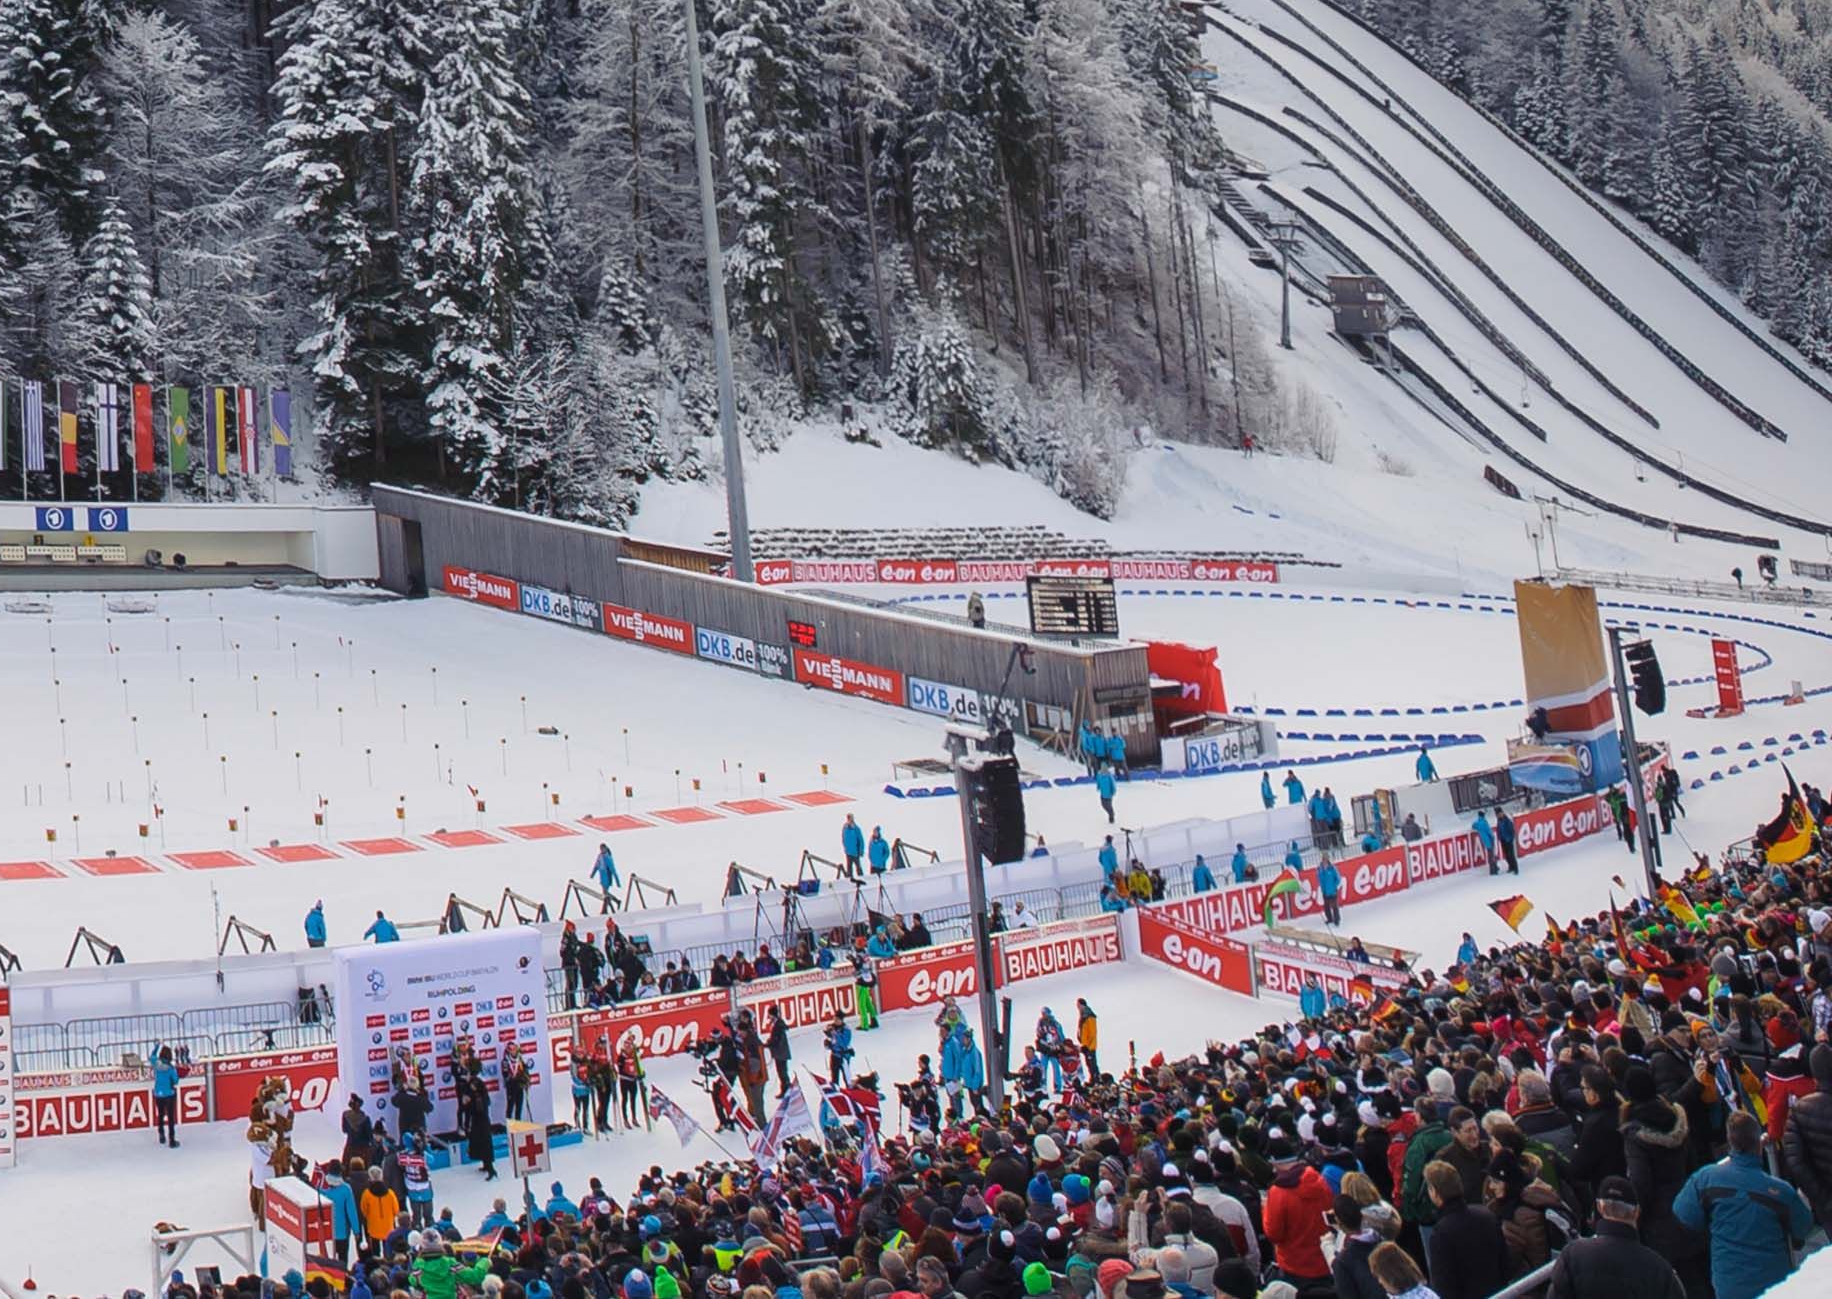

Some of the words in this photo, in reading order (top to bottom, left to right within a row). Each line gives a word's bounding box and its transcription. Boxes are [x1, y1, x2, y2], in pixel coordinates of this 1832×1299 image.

[450, 572, 511, 599] VIESSMANN
[794, 563, 877, 582] BAUHAUS
[1113, 562, 1189, 580] BAUHAUS
[524, 589, 572, 620] DKB.de
[611, 613, 684, 641] VIESSMANN
[699, 632, 753, 665] DKB.de
[758, 643, 788, 664] 100%
[803, 658, 893, 692] VIESSMANN
[911, 682, 978, 716] DKB.de
[1188, 739, 1239, 770] DKB.de
[1411, 834, 1487, 878] BAUHA
[1010, 936, 1118, 978] BAUHAUS
[762, 987, 852, 1031] AUHAU
[15, 1091, 204, 1132] BAUHAS
